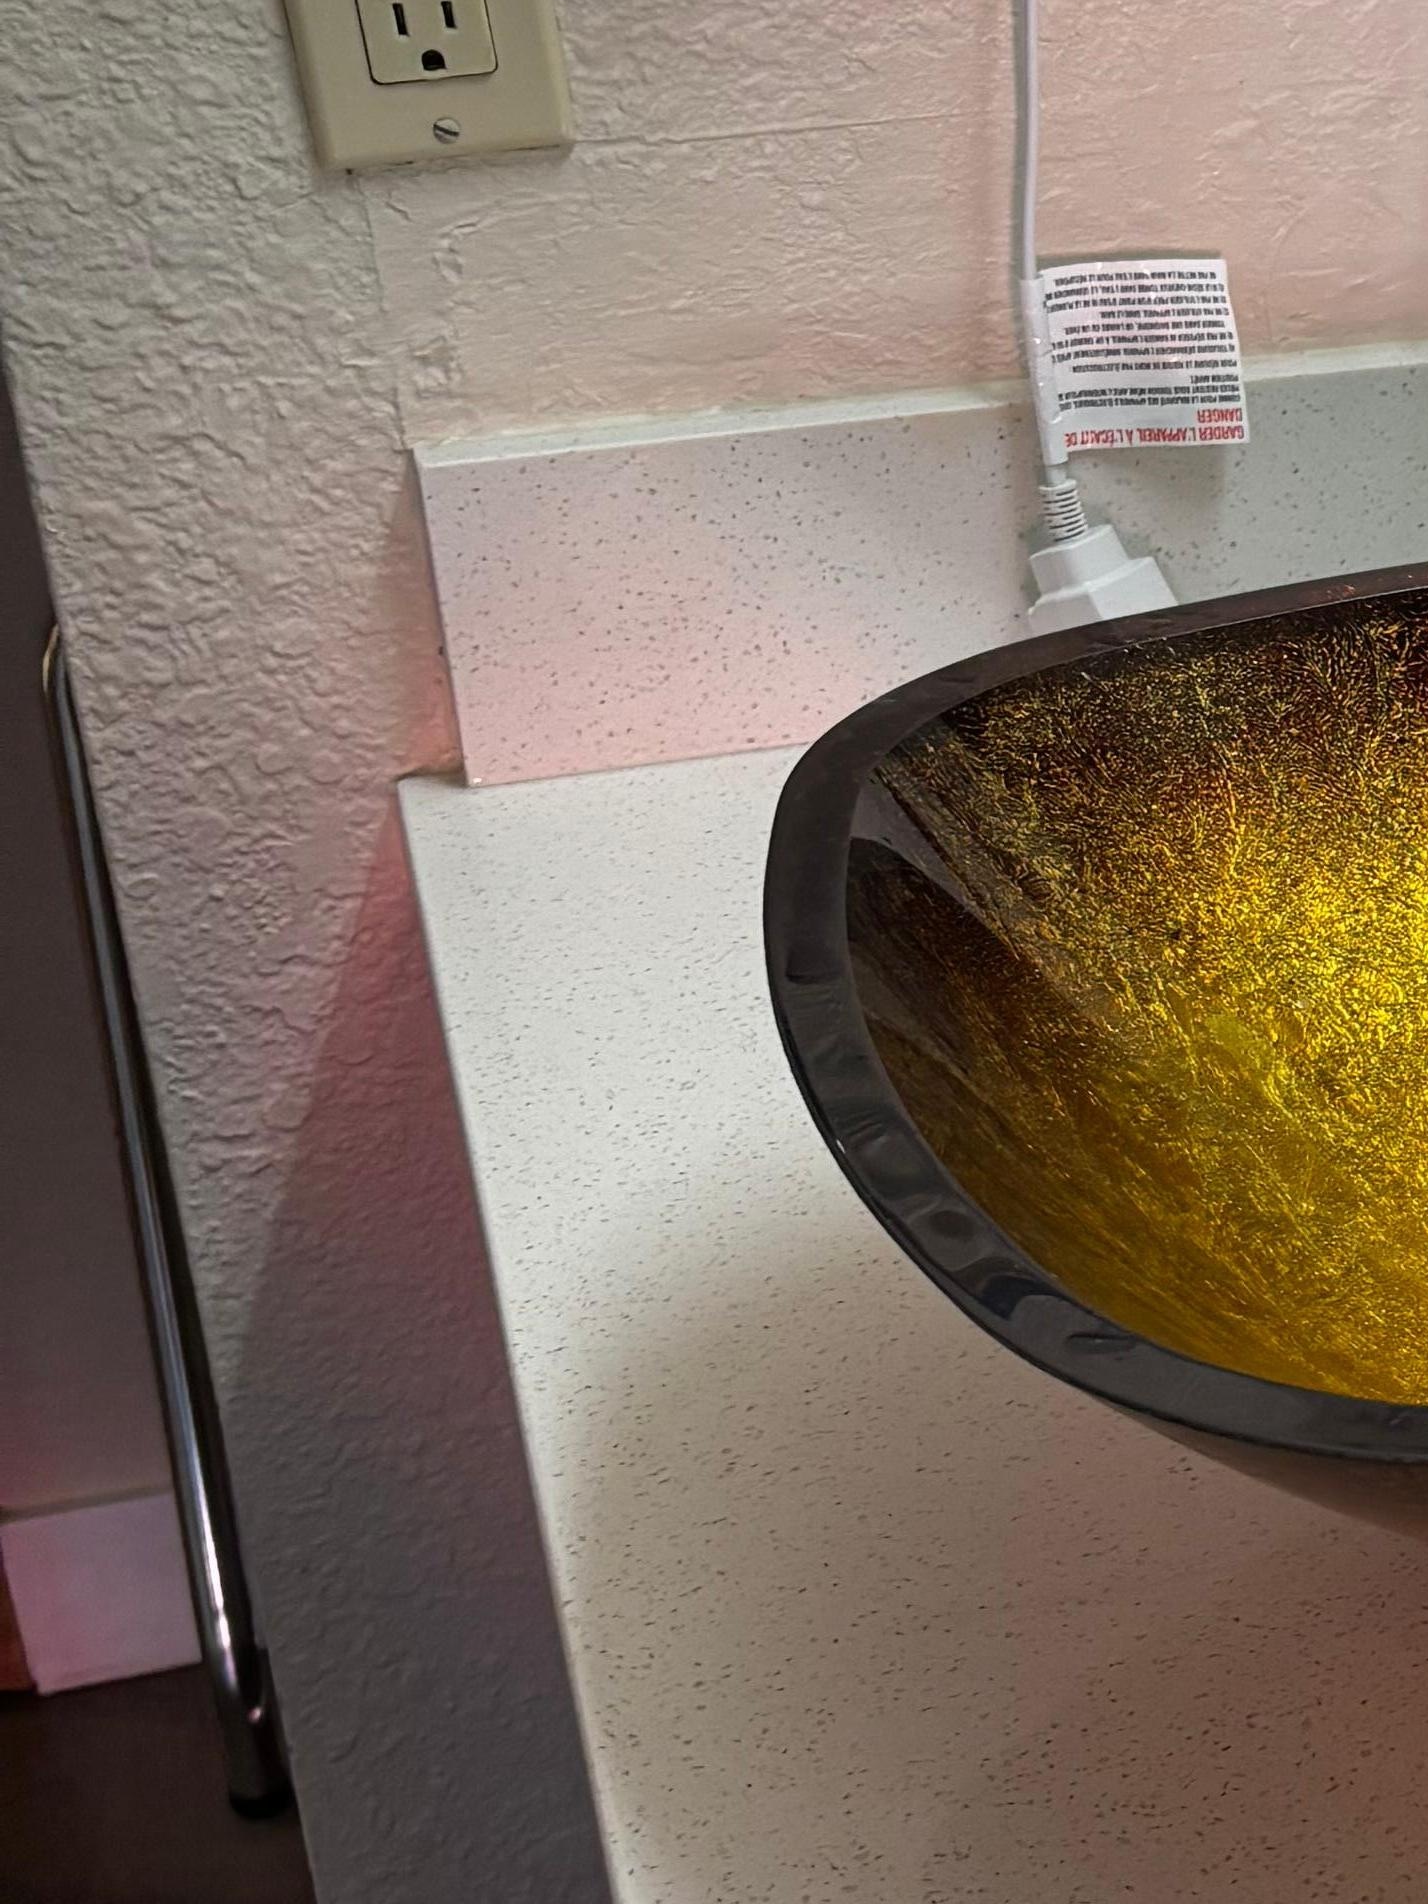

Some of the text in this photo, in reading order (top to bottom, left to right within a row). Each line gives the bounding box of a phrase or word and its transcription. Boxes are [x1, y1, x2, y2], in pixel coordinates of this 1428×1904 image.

[1197, 408, 1243, 424] DANGER
[1125, 428, 1134, 446] À
[1136, 426, 1197, 443] L'APPAREIL
[1199, 425, 1245, 442] GARDER
